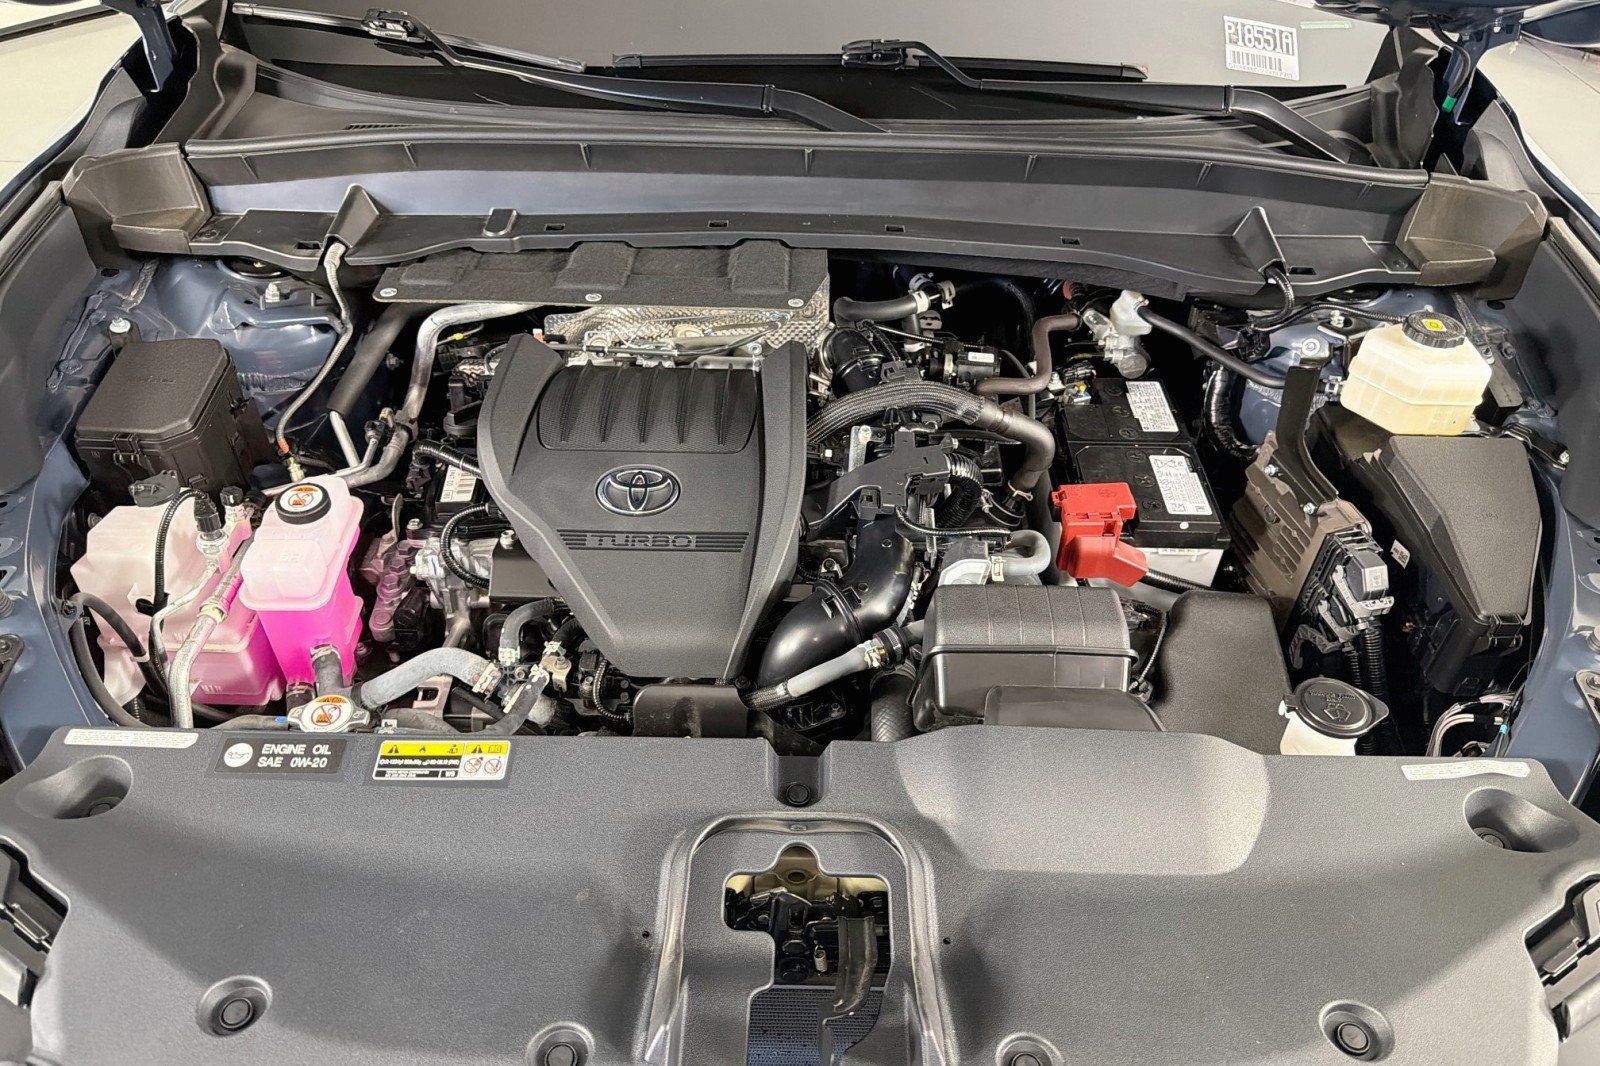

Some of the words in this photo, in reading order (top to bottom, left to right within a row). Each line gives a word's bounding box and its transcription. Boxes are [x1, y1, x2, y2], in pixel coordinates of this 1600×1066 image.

[1225, 20, 1294, 56] P18551A
[590, 534, 693, 548] TURBO
[261, 743, 307, 755] ENGINE
[312, 744, 332, 755] OIL
[257, 756, 284, 768] SAE
[290, 757, 328, 768] 0W-20
